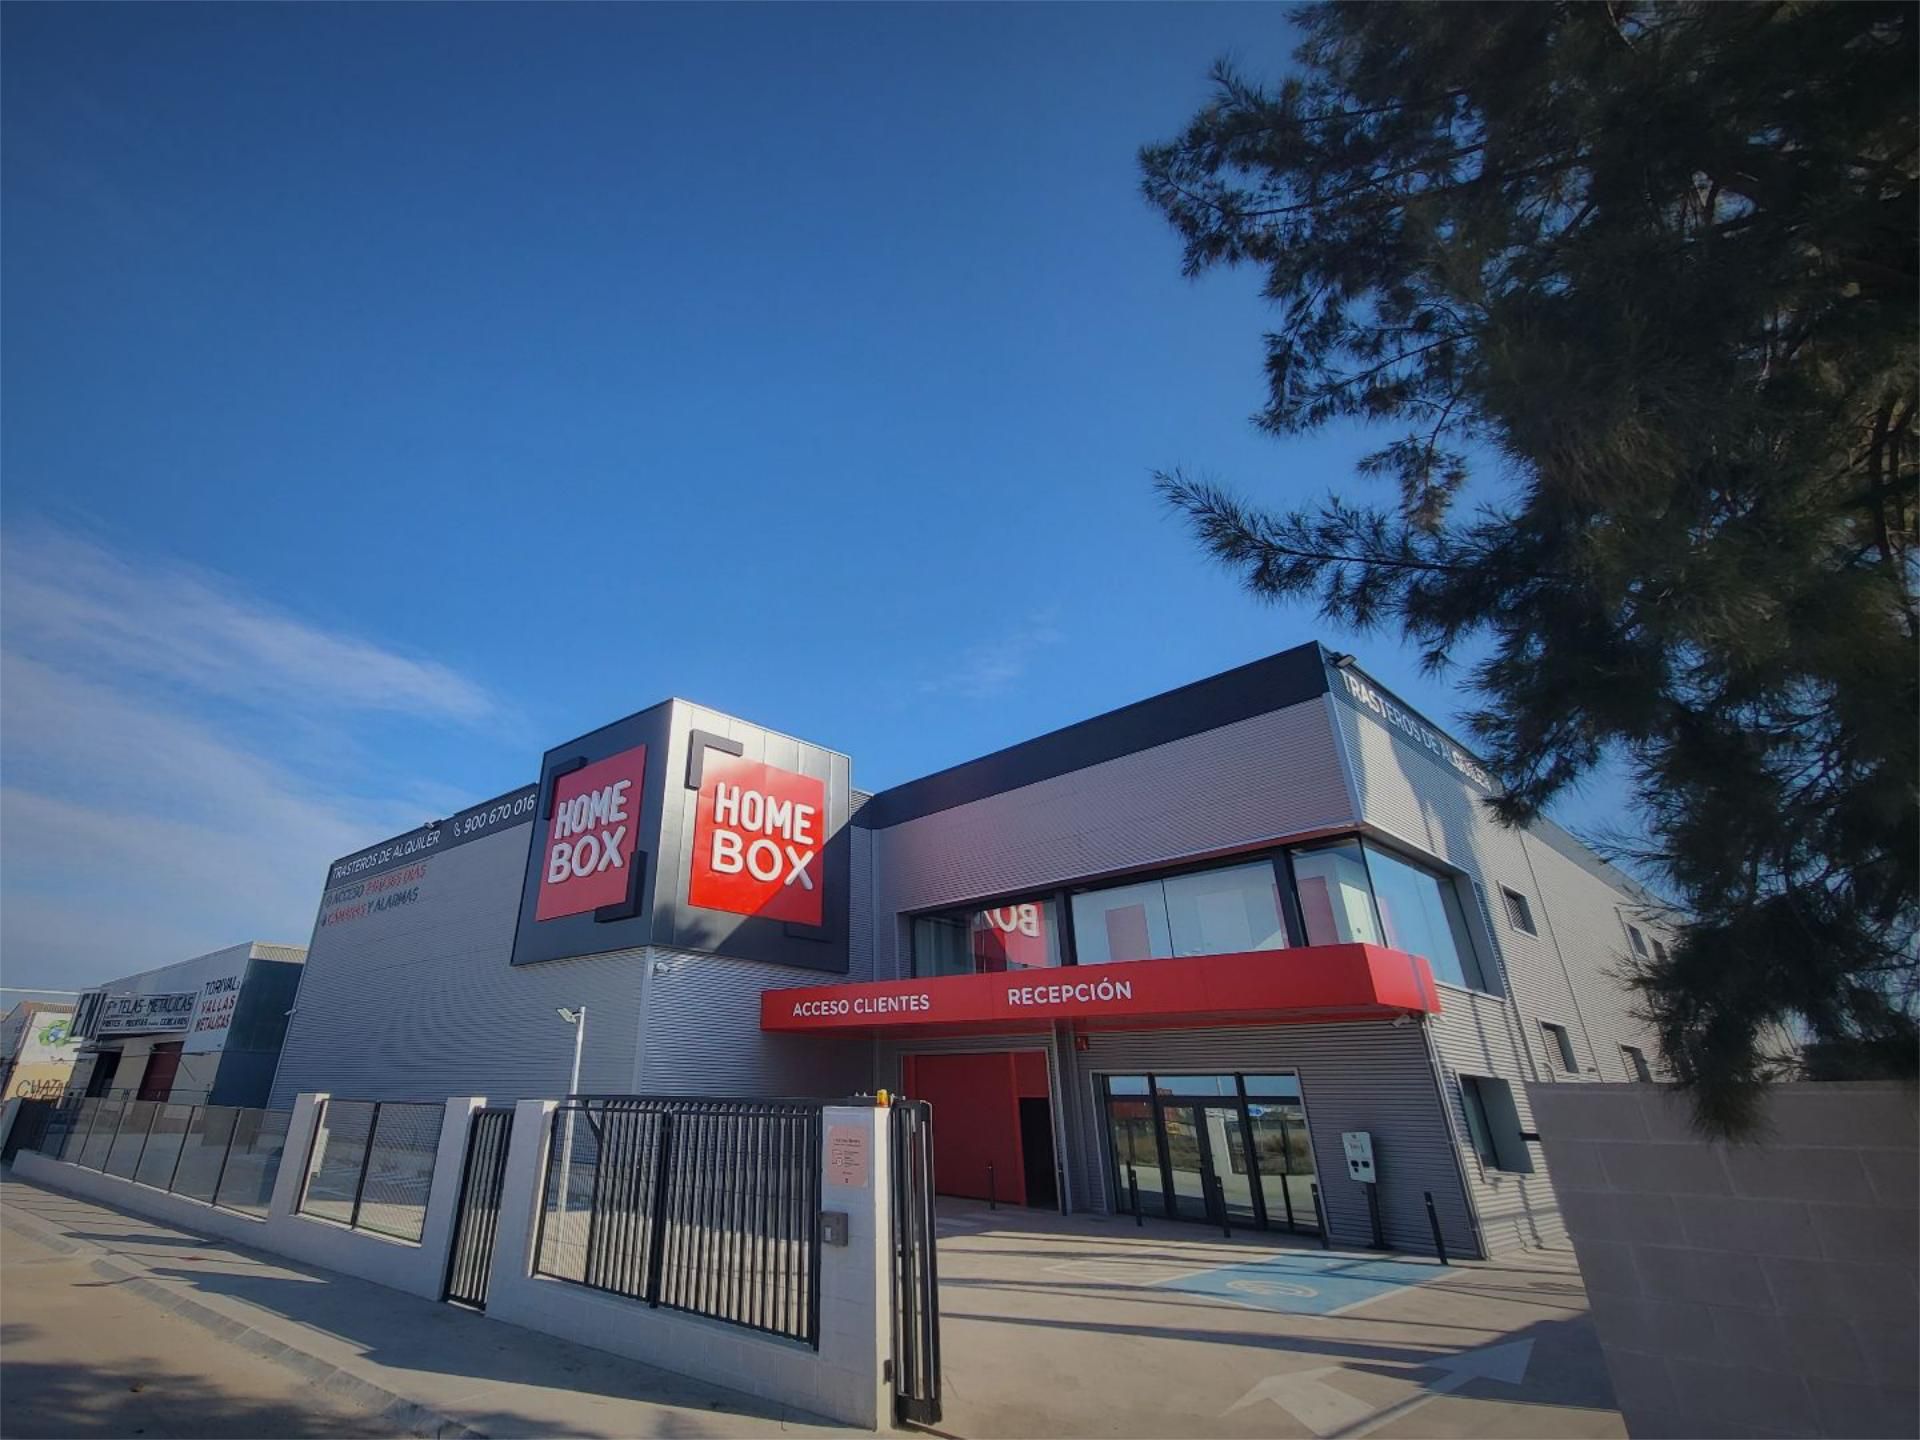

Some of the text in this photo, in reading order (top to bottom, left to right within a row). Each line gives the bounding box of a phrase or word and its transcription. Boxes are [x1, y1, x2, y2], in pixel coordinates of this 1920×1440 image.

[1339, 669, 1421, 742] TRASTEROS
[1421, 728, 1440, 756] DE
[332, 794, 536, 879] TRASTEROS DE ALQUILER 900 670 016
[554, 780, 631, 840] HOME
[714, 782, 815, 845] HOME
[548, 826, 626, 885] BOX
[711, 829, 814, 890] BOX
[367, 900, 376, 913] Y
[375, 886, 420, 912] ALARMAS
[201, 995, 236, 1014] VALLAS
[792, 994, 930, 1018] ACCESO CLIENTES
[1007, 976, 1132, 1006] RECEPCIÓN
